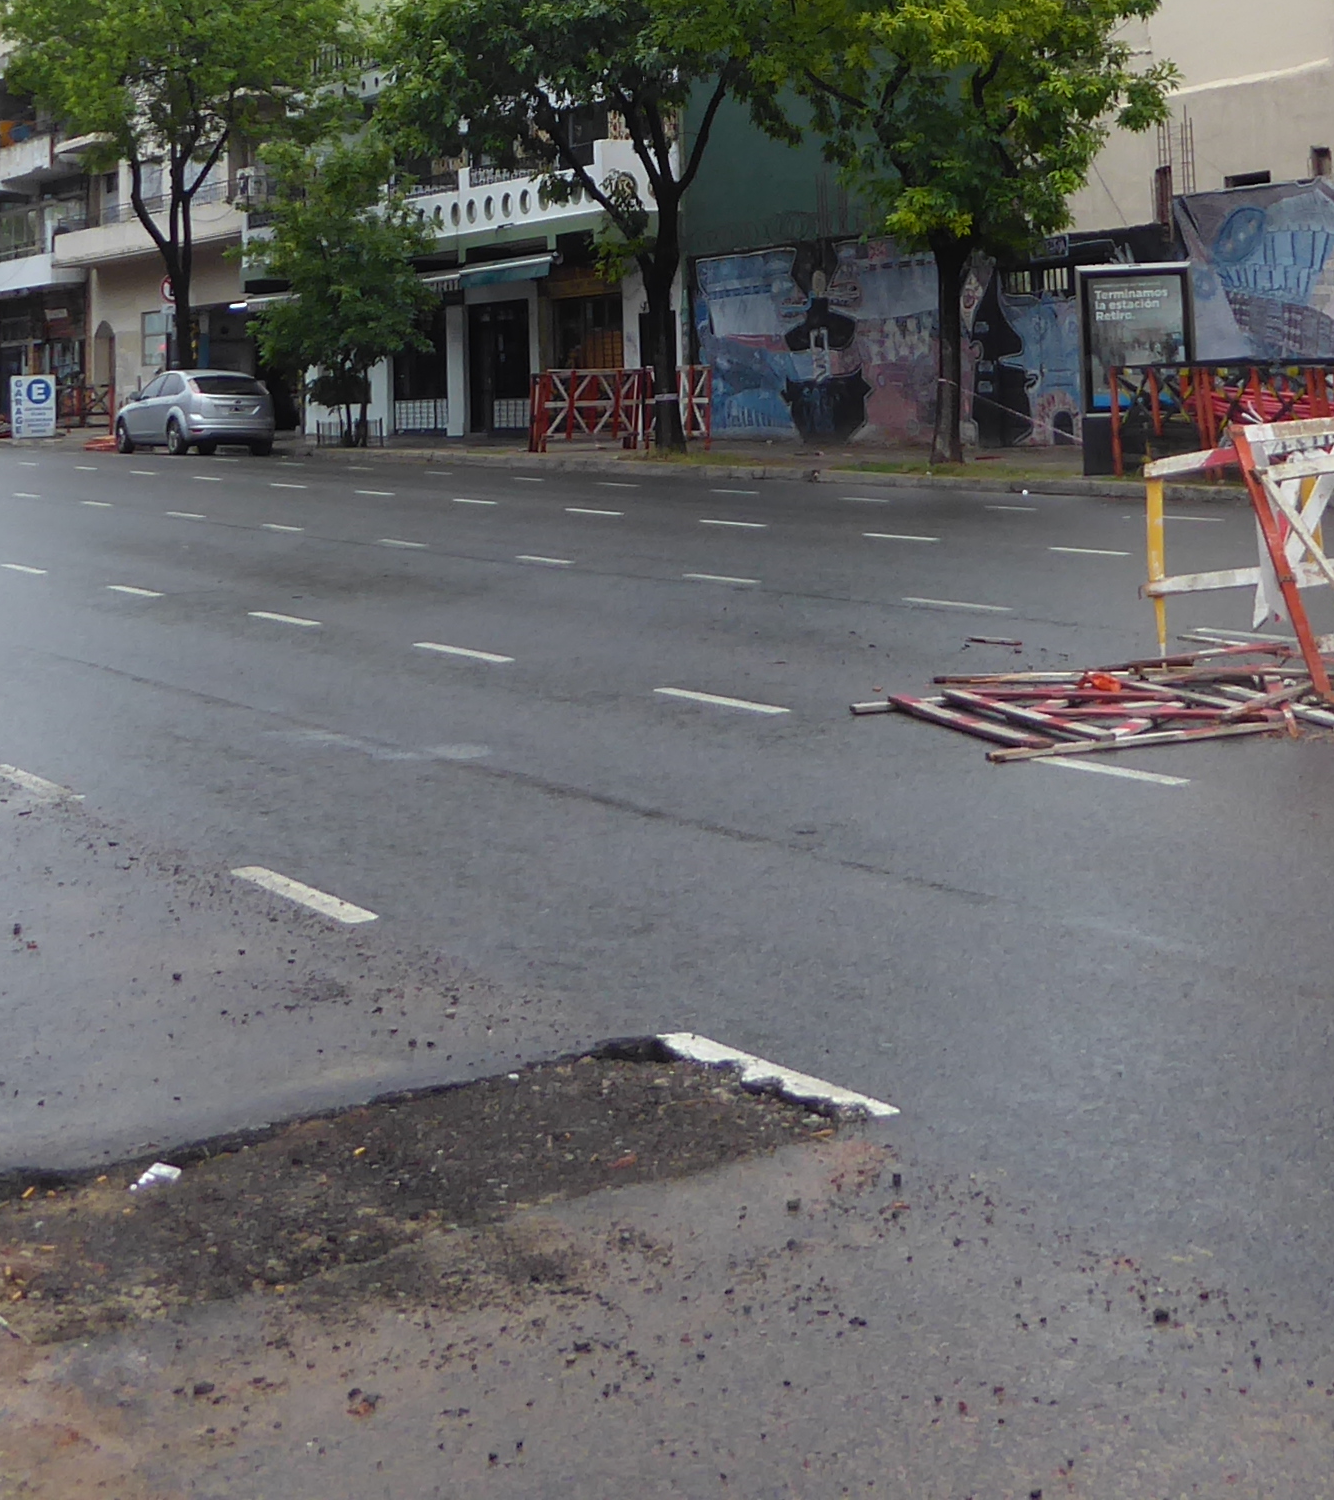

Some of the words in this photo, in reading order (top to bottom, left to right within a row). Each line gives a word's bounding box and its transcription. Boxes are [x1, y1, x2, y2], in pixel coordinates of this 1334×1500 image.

[1094, 289, 1168, 300] Terminamos
[1095, 301, 1106, 311] la
[1109, 299, 1160, 310] estación
[31, 383, 47, 400] E
[15, 379, 23, 435] GARAGE
